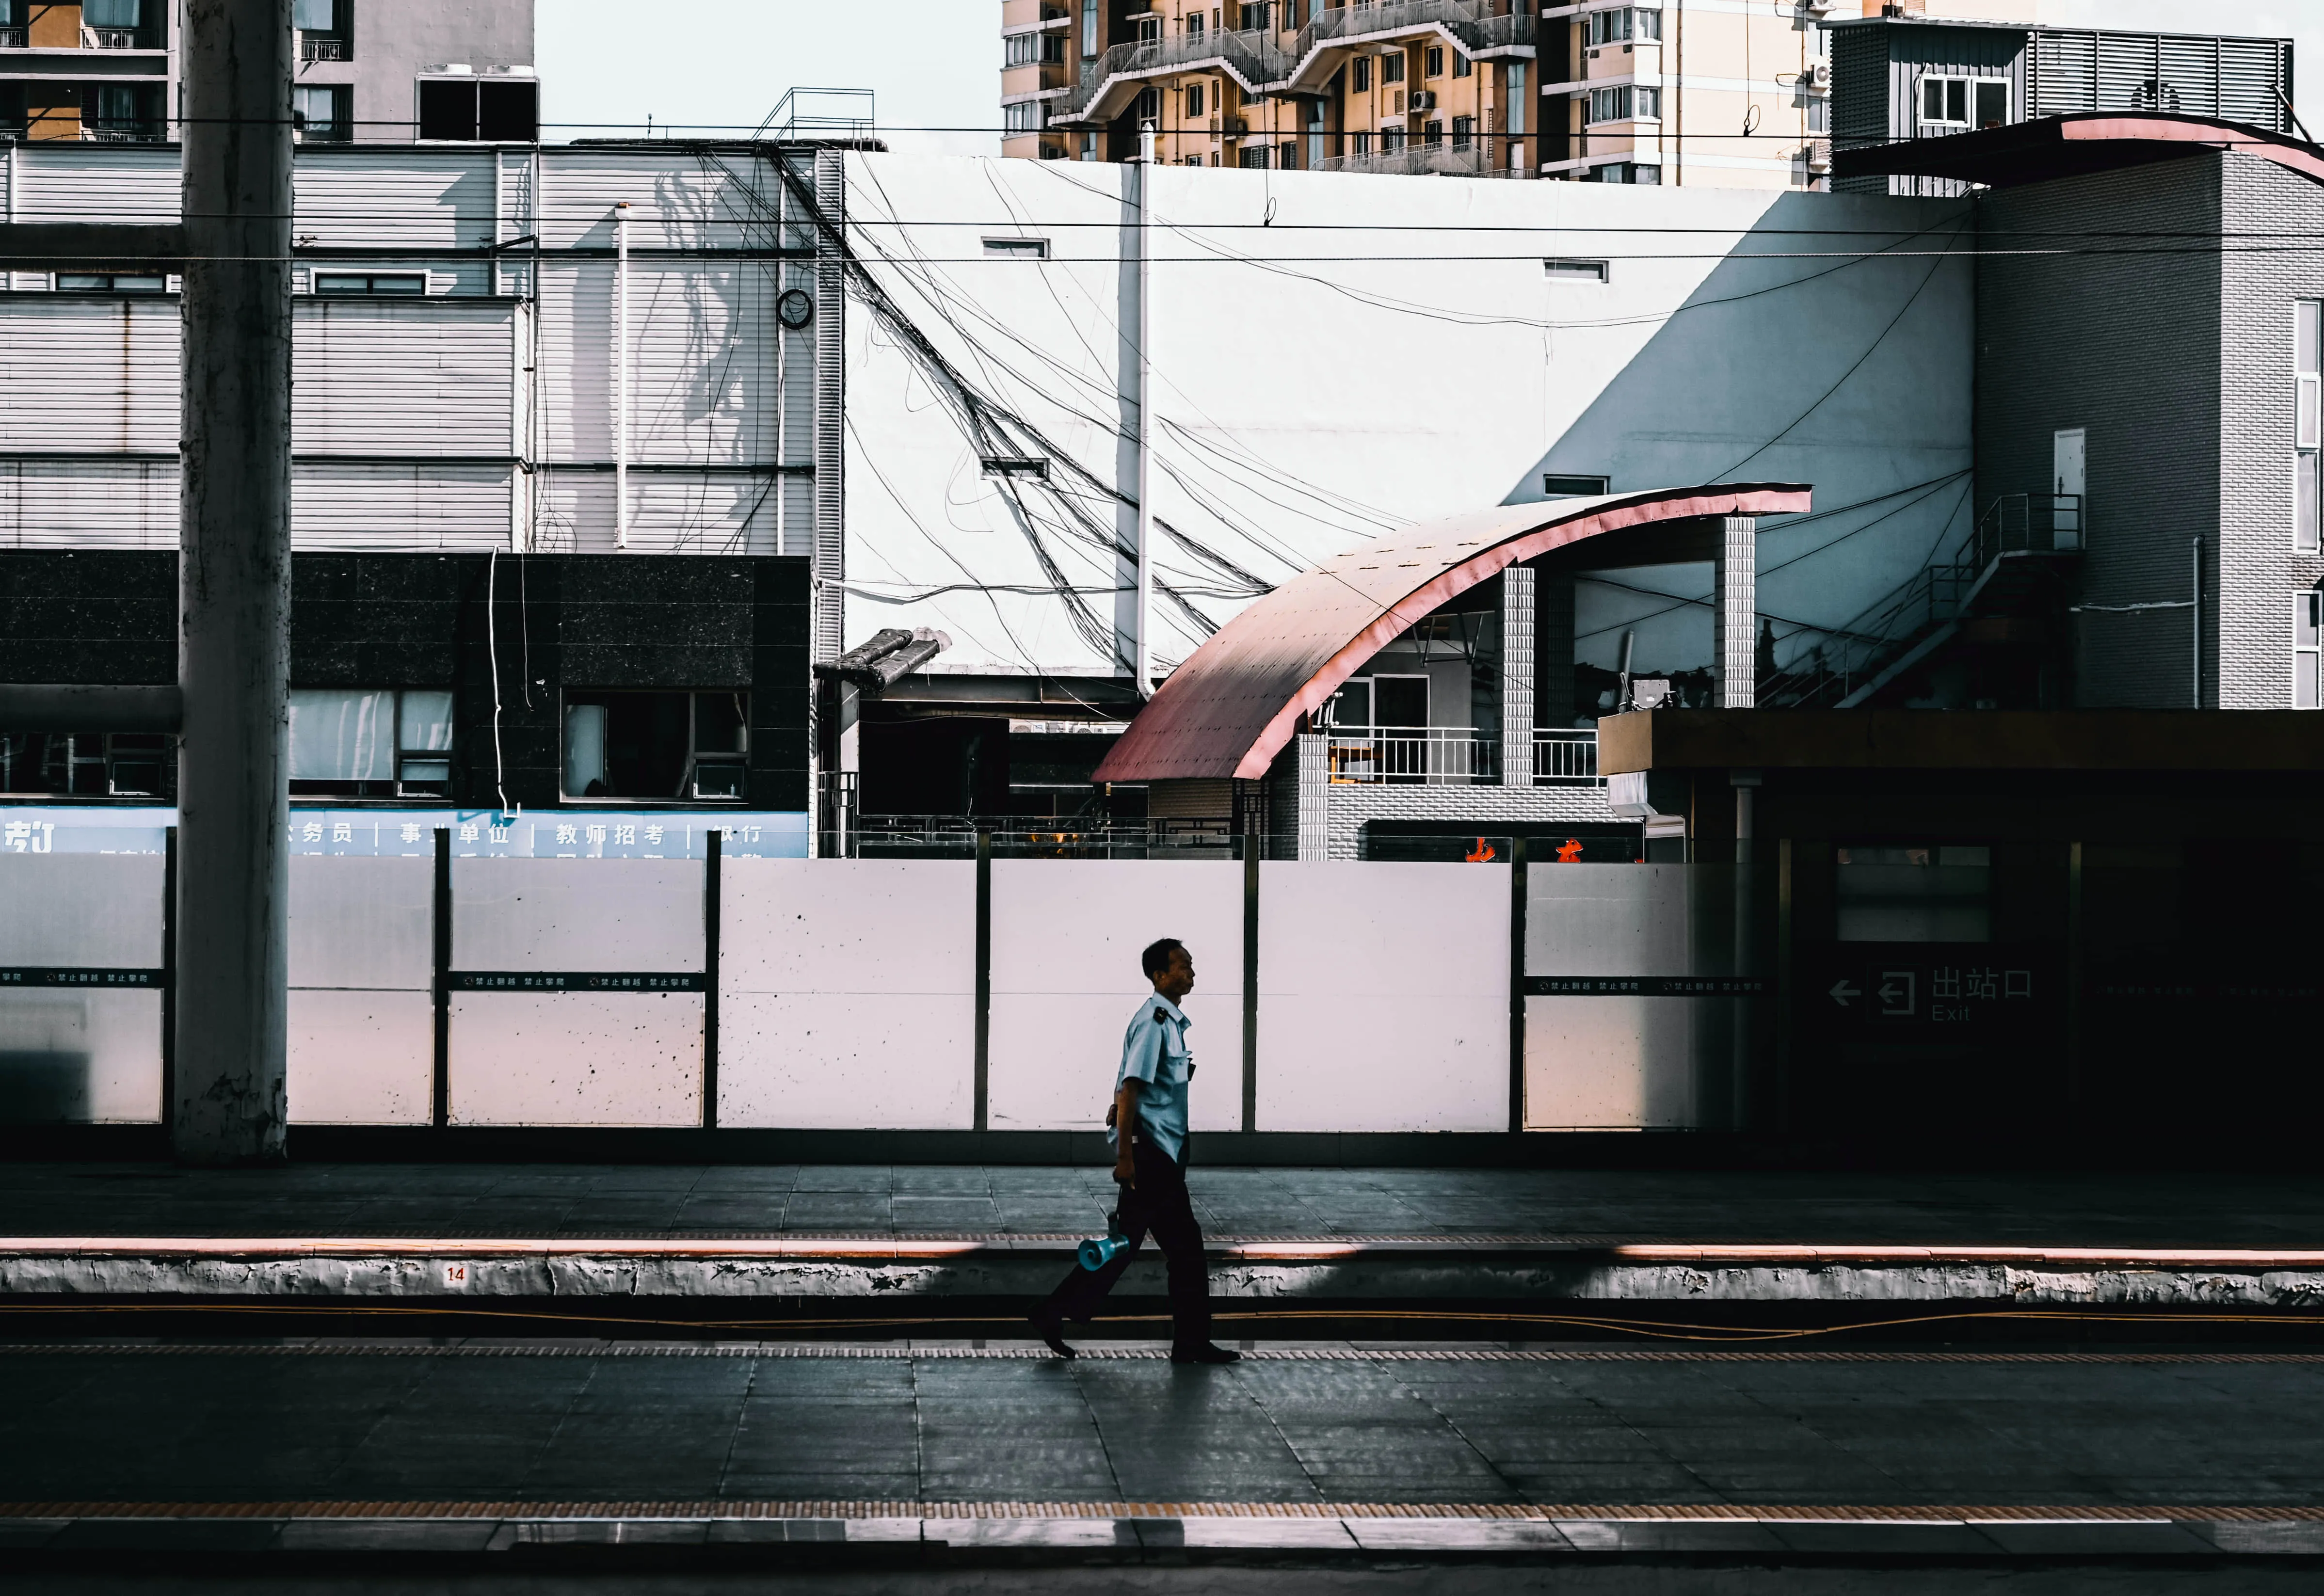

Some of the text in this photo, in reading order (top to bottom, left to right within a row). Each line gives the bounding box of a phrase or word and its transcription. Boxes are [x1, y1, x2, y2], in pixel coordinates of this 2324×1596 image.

[556, 823, 664, 845] 教师招考
[1932, 965, 2032, 1001] 出站口
[1932, 1004, 1971, 1021] Exit
[447, 1267, 465, 1281] 14
